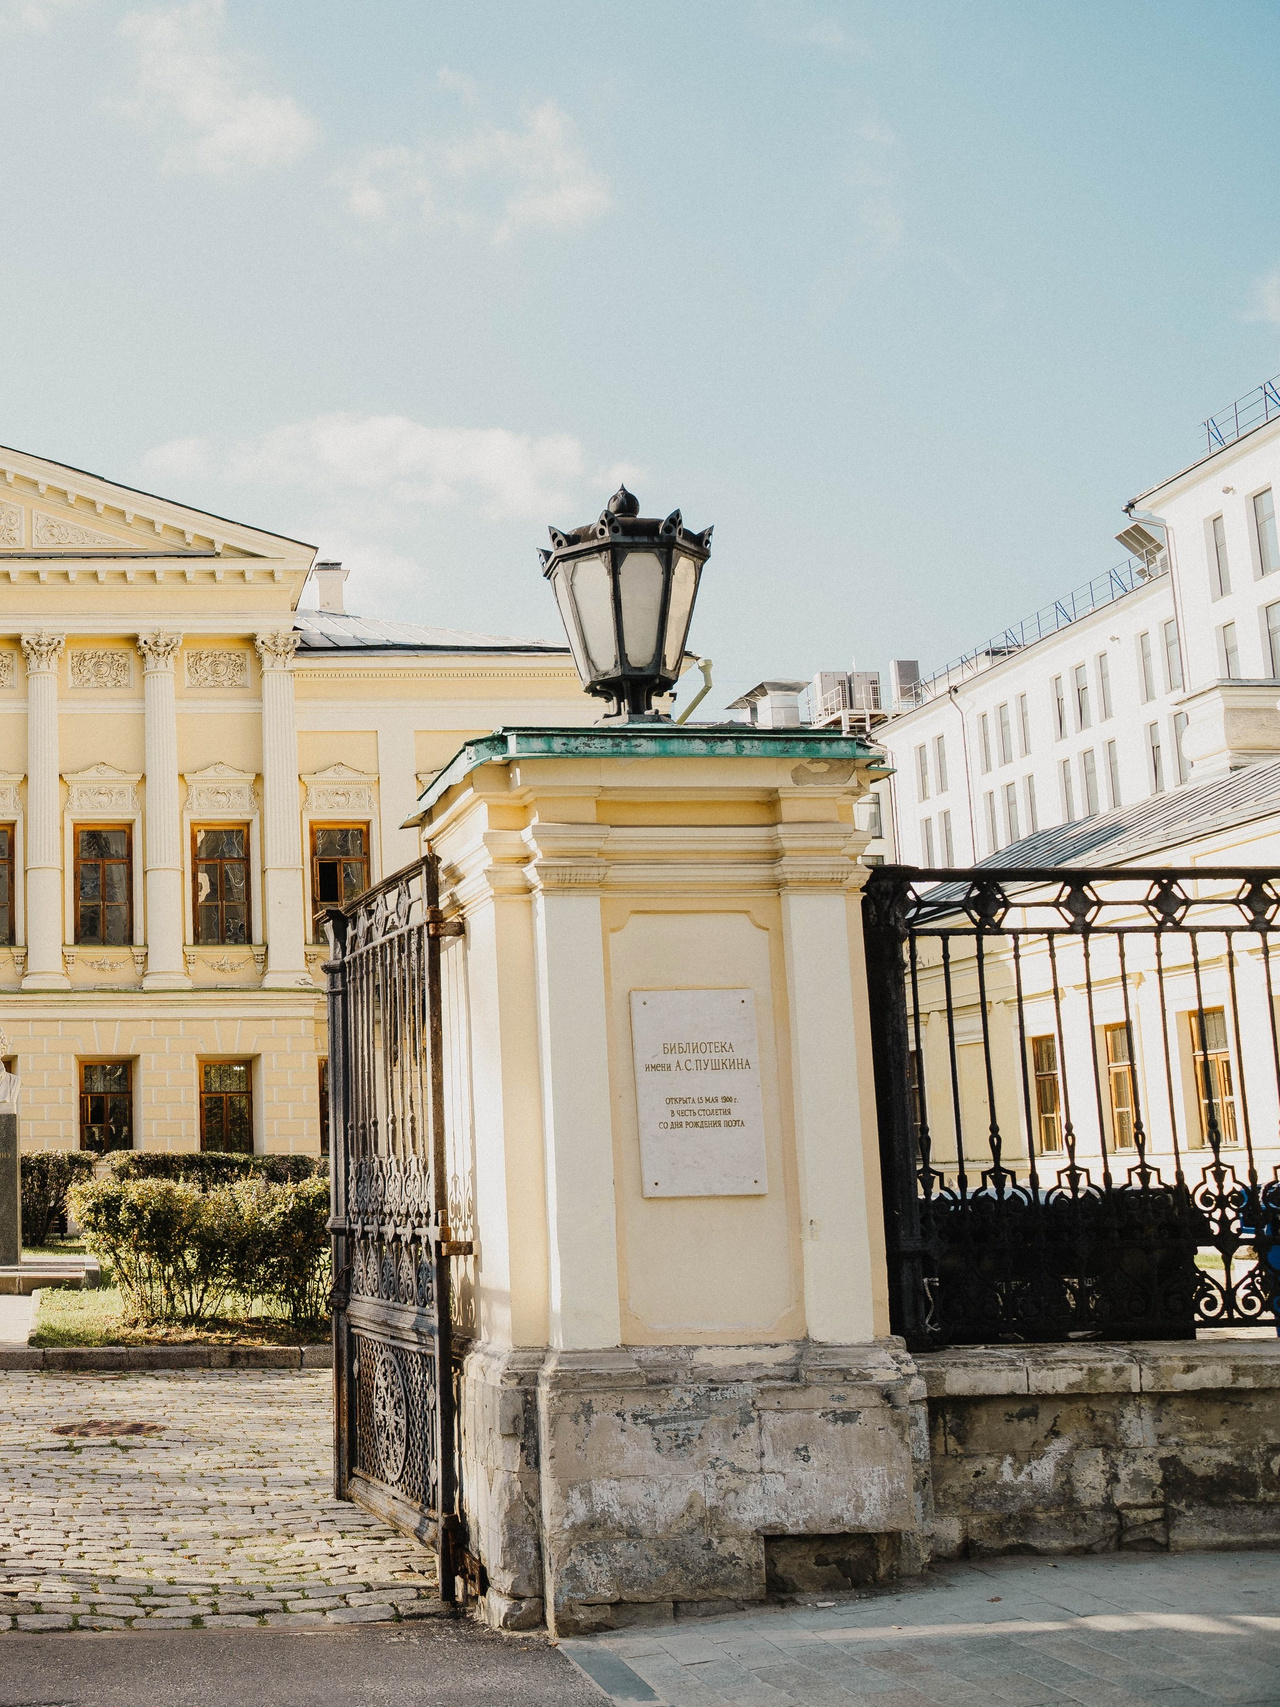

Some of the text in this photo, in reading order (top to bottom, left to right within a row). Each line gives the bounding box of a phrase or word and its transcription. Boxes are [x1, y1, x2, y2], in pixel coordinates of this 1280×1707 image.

[662, 1041, 734, 1055] БИБЛИОТЕКА
[644, 1058, 751, 1072] имени А.С.ПУШКИНА
[665, 1096, 696, 1105] ОТКРЫТА
[705, 1096, 718, 1104] МАЯ
[721, 1095, 733, 1103] 1900
[670, 1108, 732, 1117] В ЧЕСТЬ СТОЛЕТИЯ
[658, 1119, 745, 1130] СО ДНЯ РОЖДЕНИЯ ПОЭТА
